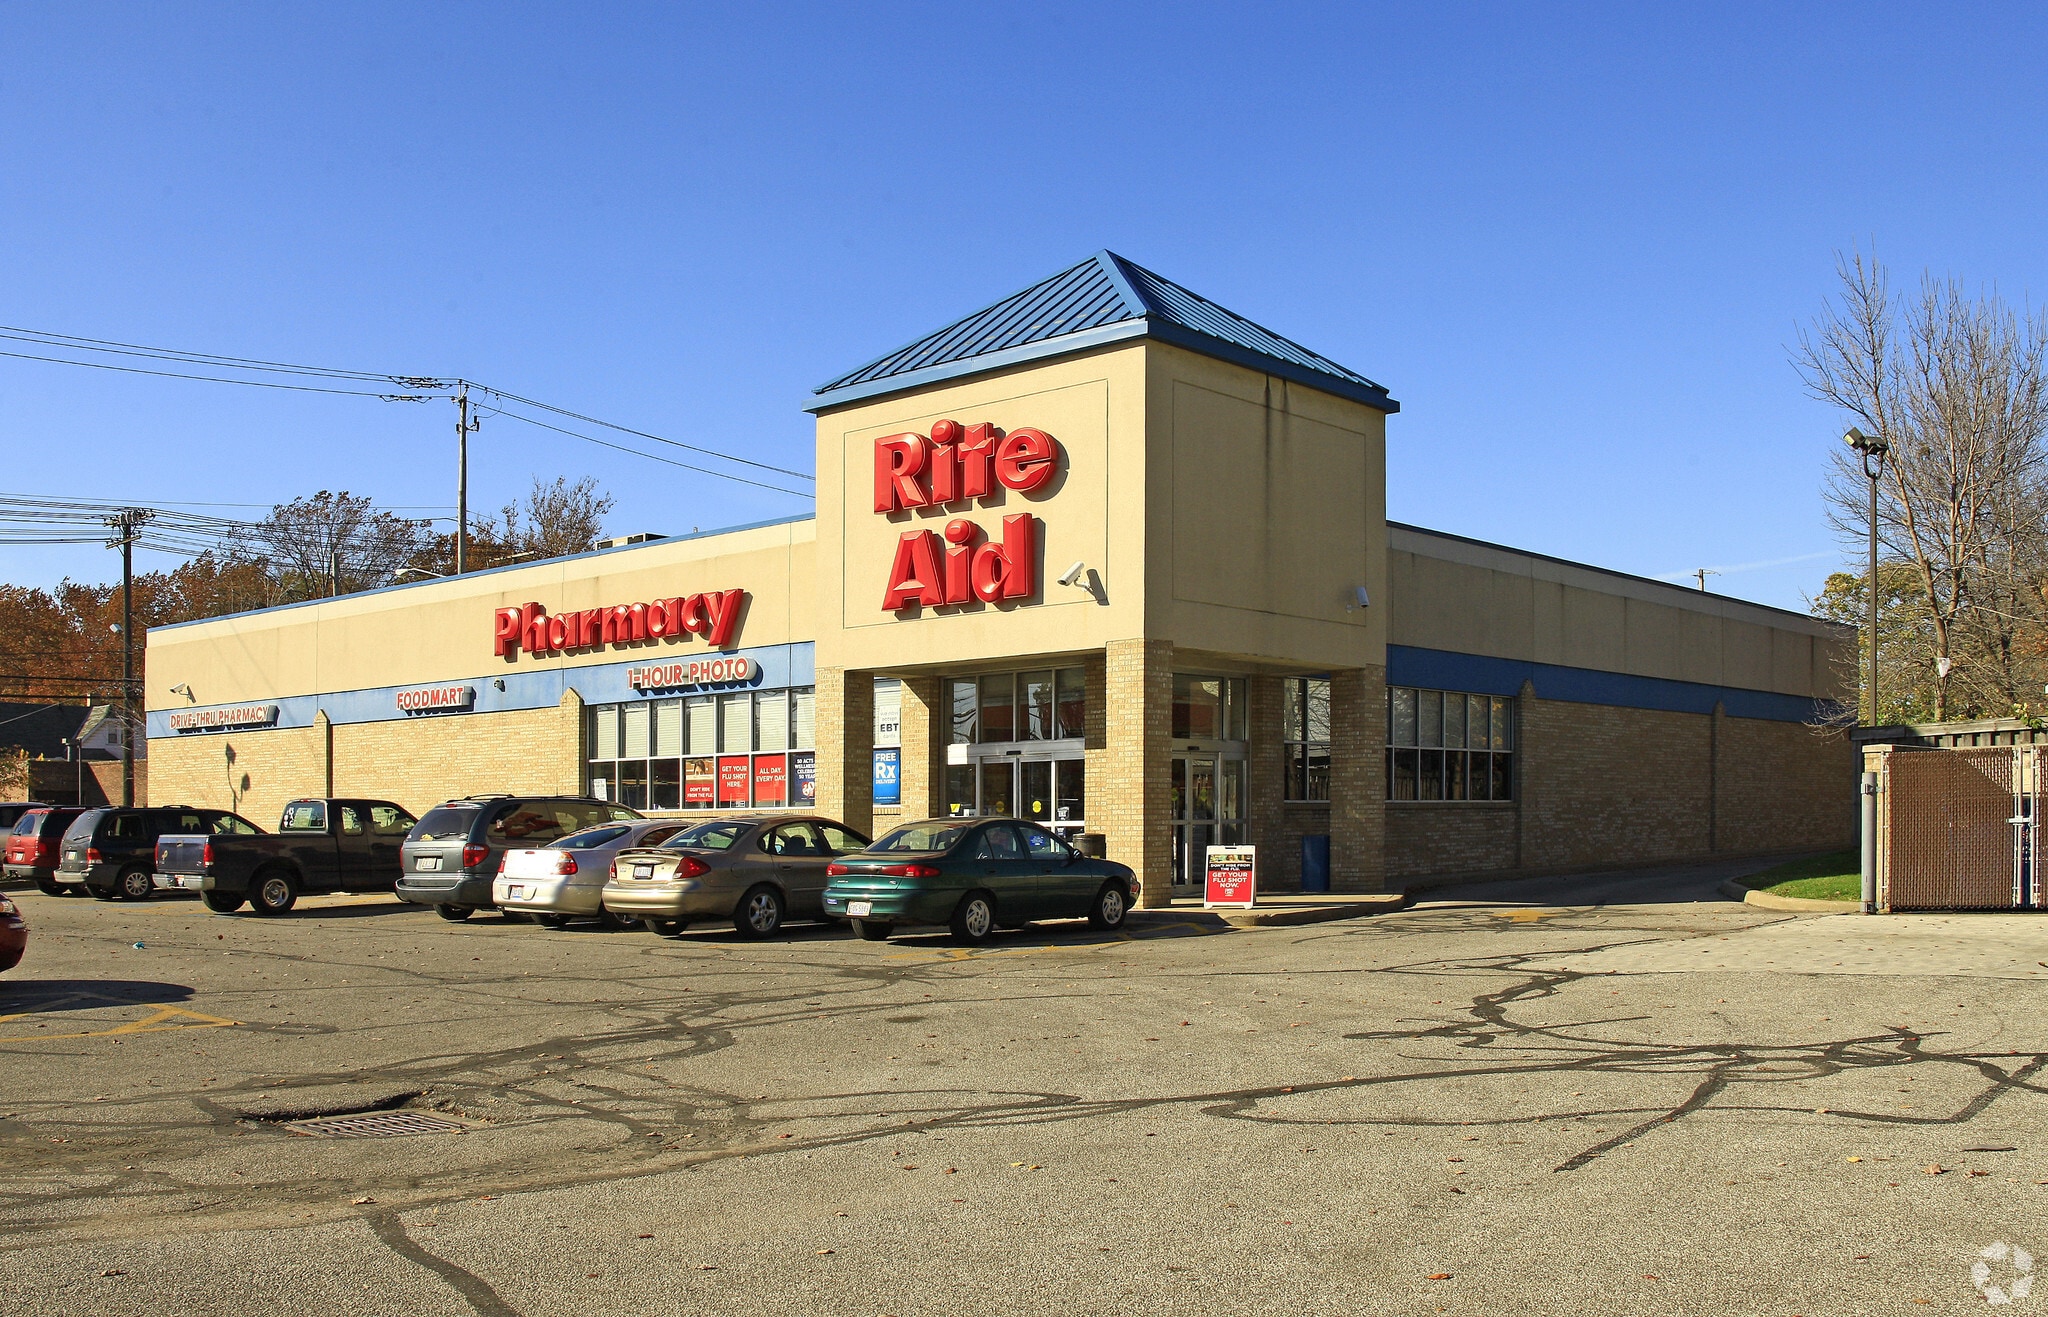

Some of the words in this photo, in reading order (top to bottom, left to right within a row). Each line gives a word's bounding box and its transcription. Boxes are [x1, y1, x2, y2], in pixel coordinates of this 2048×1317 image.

[874, 419, 1059, 515] Rite
[881, 512, 1033, 611] Aid
[494, 588, 744, 656] Pharmacy
[627, 663, 683, 690] 1-HOUR
[689, 657, 749, 684] PHOTO
[397, 686, 464, 709] FOODMART
[170, 711, 217, 729] DRIVE-THRU
[218, 705, 268, 724] PHARMACY
[880, 723, 899, 732] EBT
[876, 753, 896, 761] FREE
[876, 762, 896, 778] Rx
